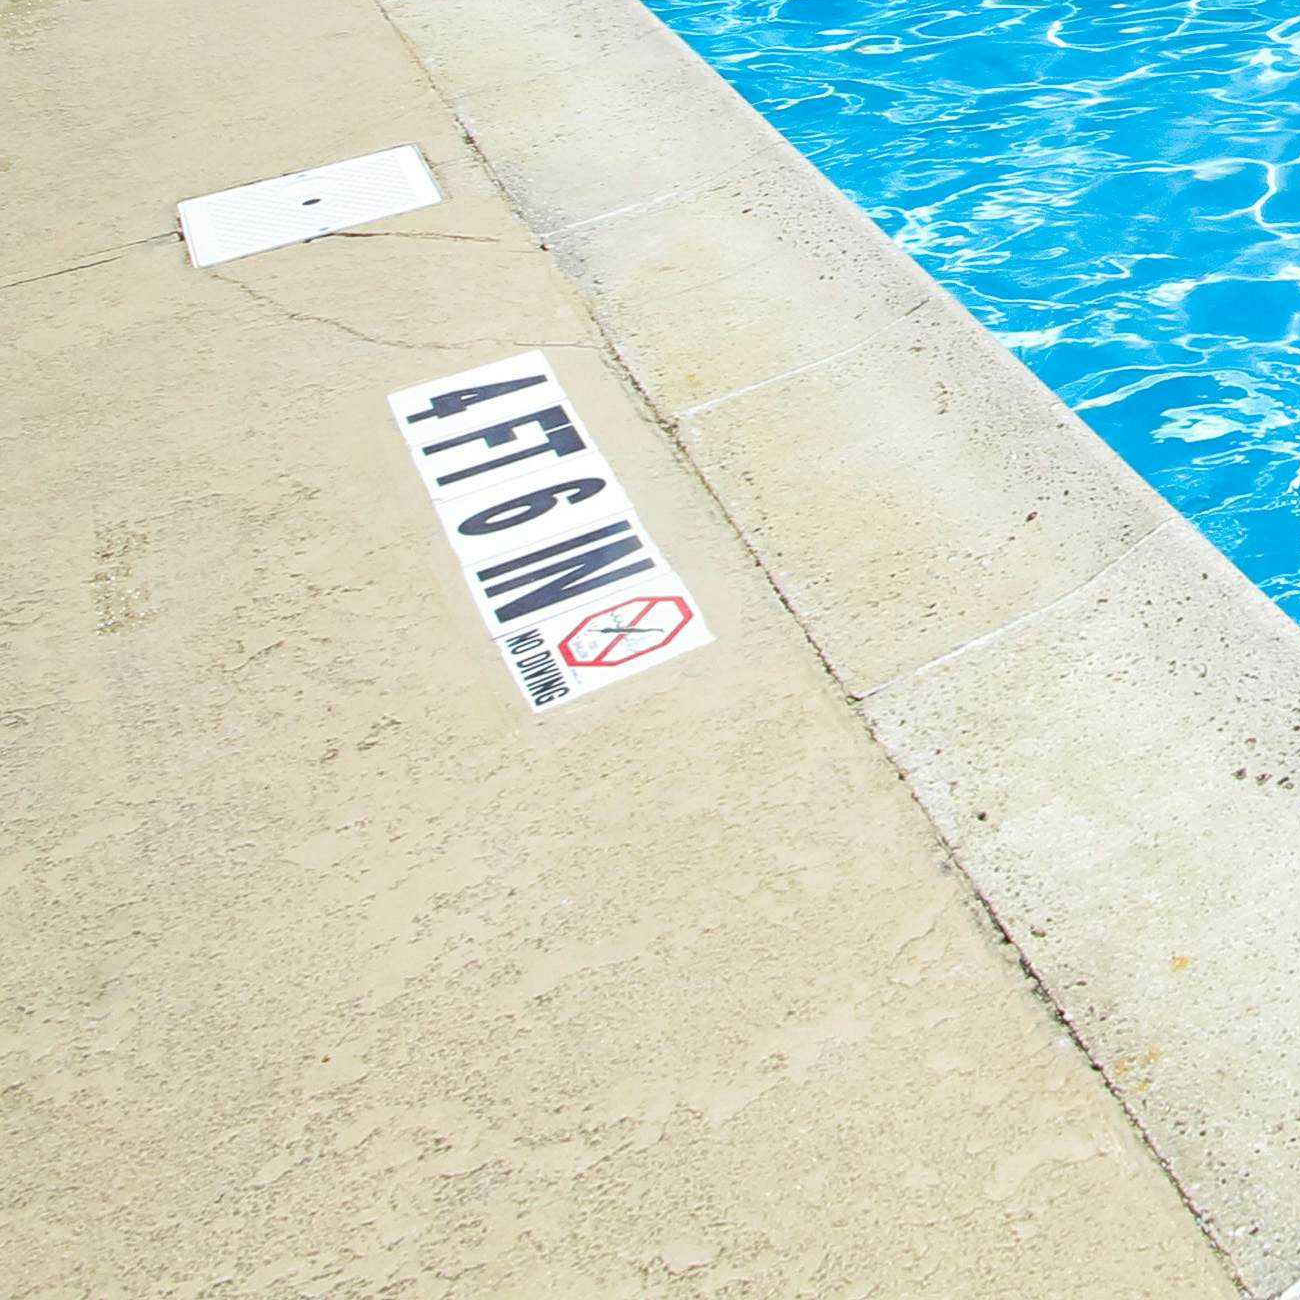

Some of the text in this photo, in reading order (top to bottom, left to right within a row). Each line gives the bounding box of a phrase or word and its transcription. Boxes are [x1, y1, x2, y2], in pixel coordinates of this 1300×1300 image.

[407, 374, 656, 624] 4 FT 6 IN
[505, 628, 570, 706] NO DIVING
